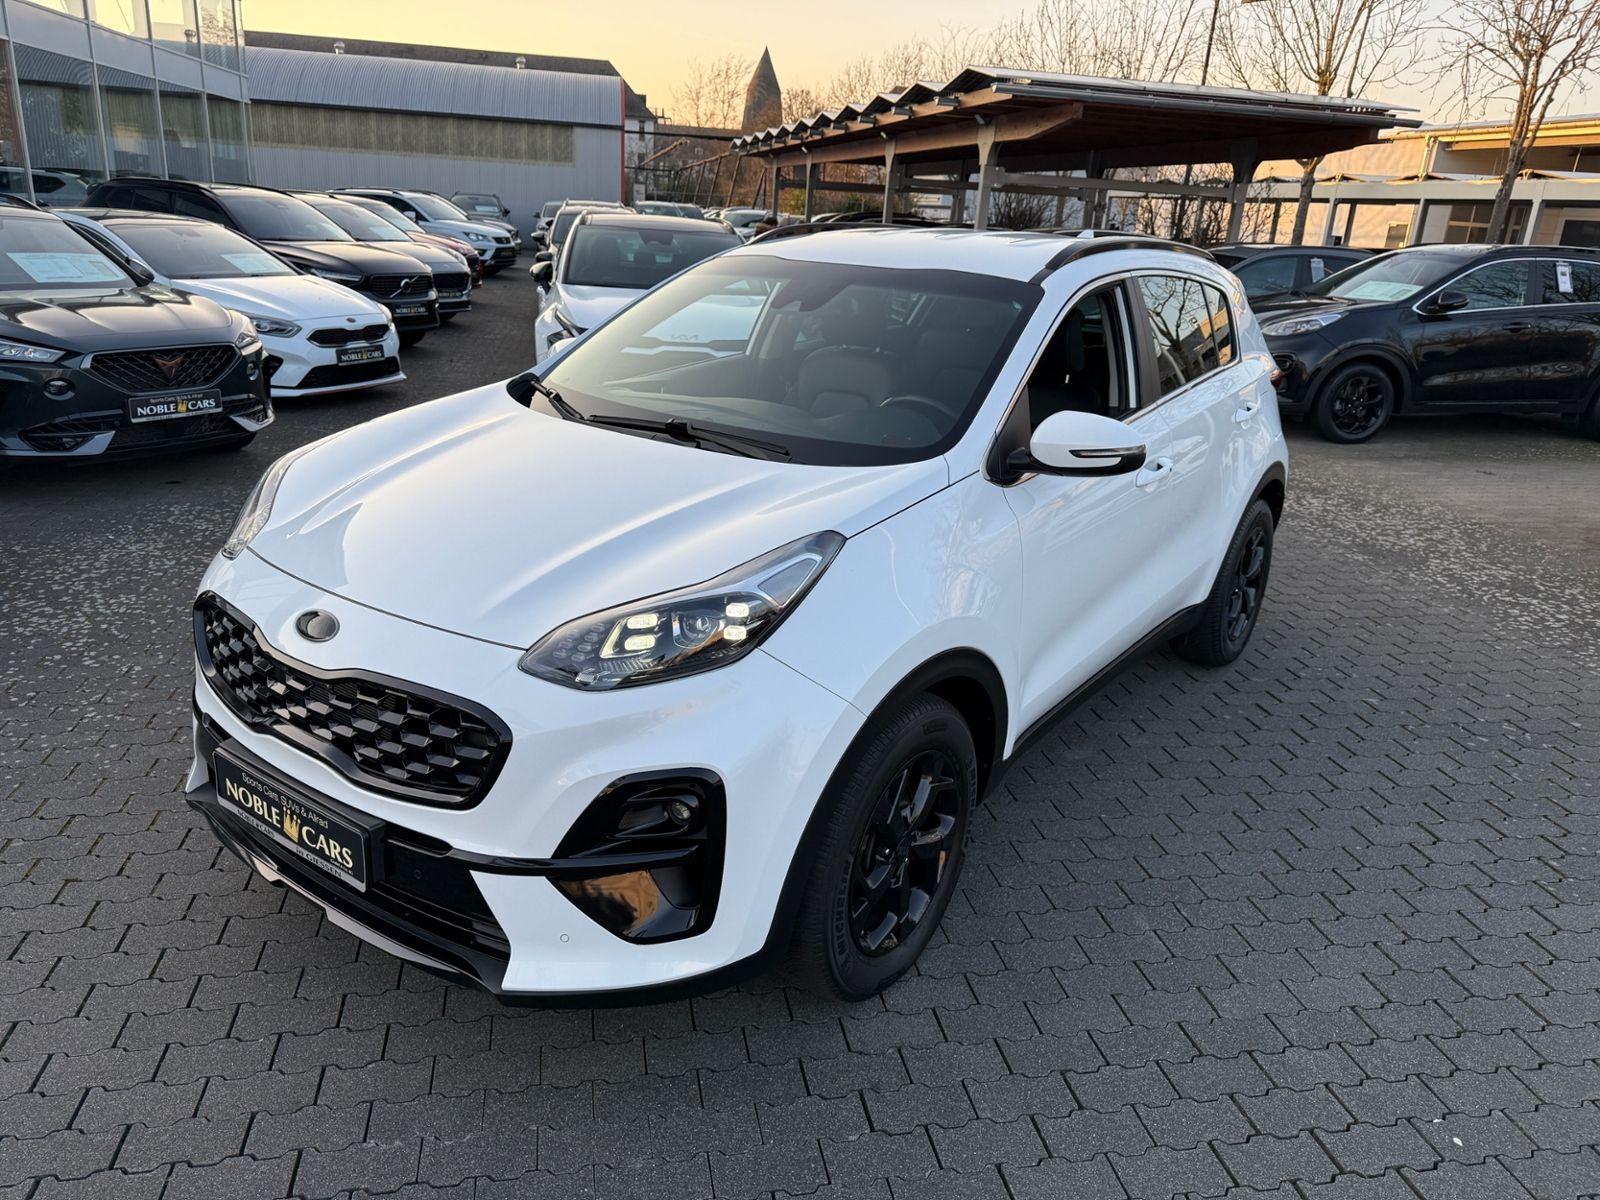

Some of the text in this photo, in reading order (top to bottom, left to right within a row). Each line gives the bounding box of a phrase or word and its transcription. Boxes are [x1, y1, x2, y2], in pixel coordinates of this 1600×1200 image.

[341, 351, 363, 360] NOBLE
[137, 399, 216, 416] NOBLE CARS
[242, 772, 263, 792] Sports
[281, 796, 300, 813] SUVs
[300, 808, 307, 818] &
[308, 812, 329, 829] Allrad
[225, 778, 353, 868] NOBLE CARS
[306, 853, 342, 878] GIESSEN
